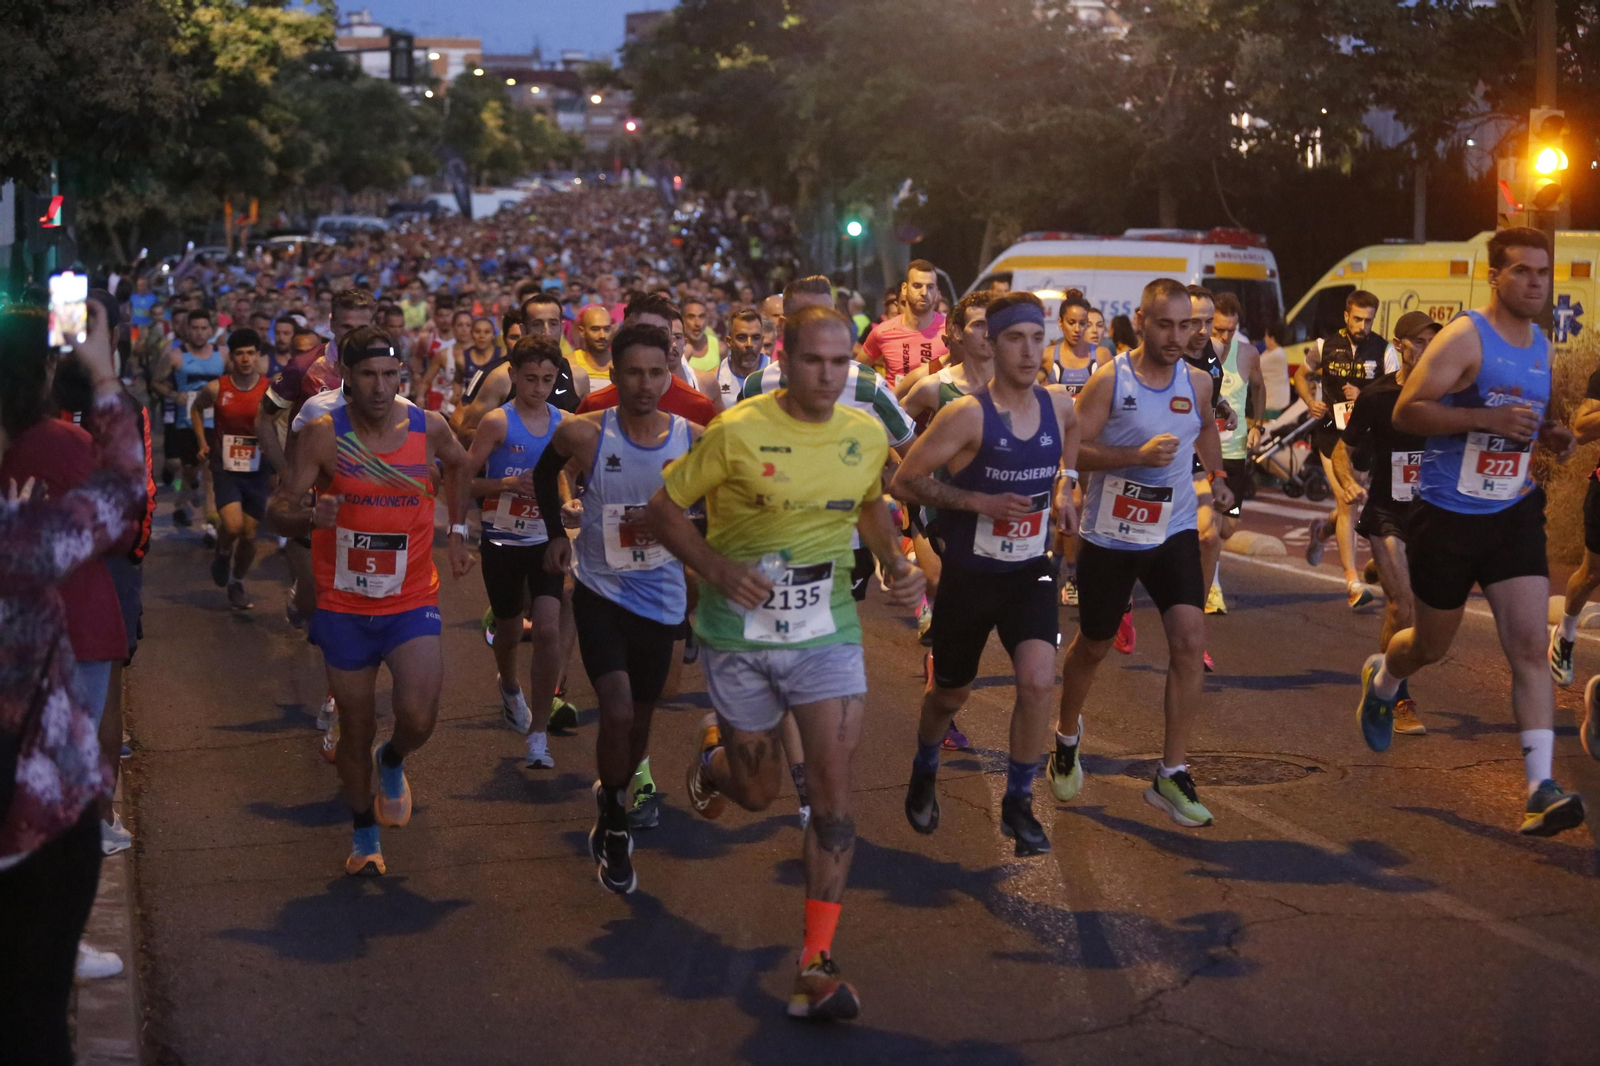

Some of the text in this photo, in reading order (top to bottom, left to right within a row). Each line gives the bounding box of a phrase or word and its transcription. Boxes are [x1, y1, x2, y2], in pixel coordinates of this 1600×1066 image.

[1100, 300, 1132, 315] TSS
[1429, 306, 1454, 321] 667
[1484, 391, 1504, 406] 20
[1489, 438, 1505, 451] 21
[233, 449, 252, 459] 132
[1410, 454, 1421, 465] 21
[1483, 459, 1514, 476] 272
[1125, 485, 1141, 499] 21
[520, 505, 540, 518] 25
[1125, 504, 1149, 522] 70
[1007, 521, 1031, 538] 20
[356, 535, 372, 550] 21
[365, 557, 376, 573] 5
[762, 585, 820, 610] 2135
